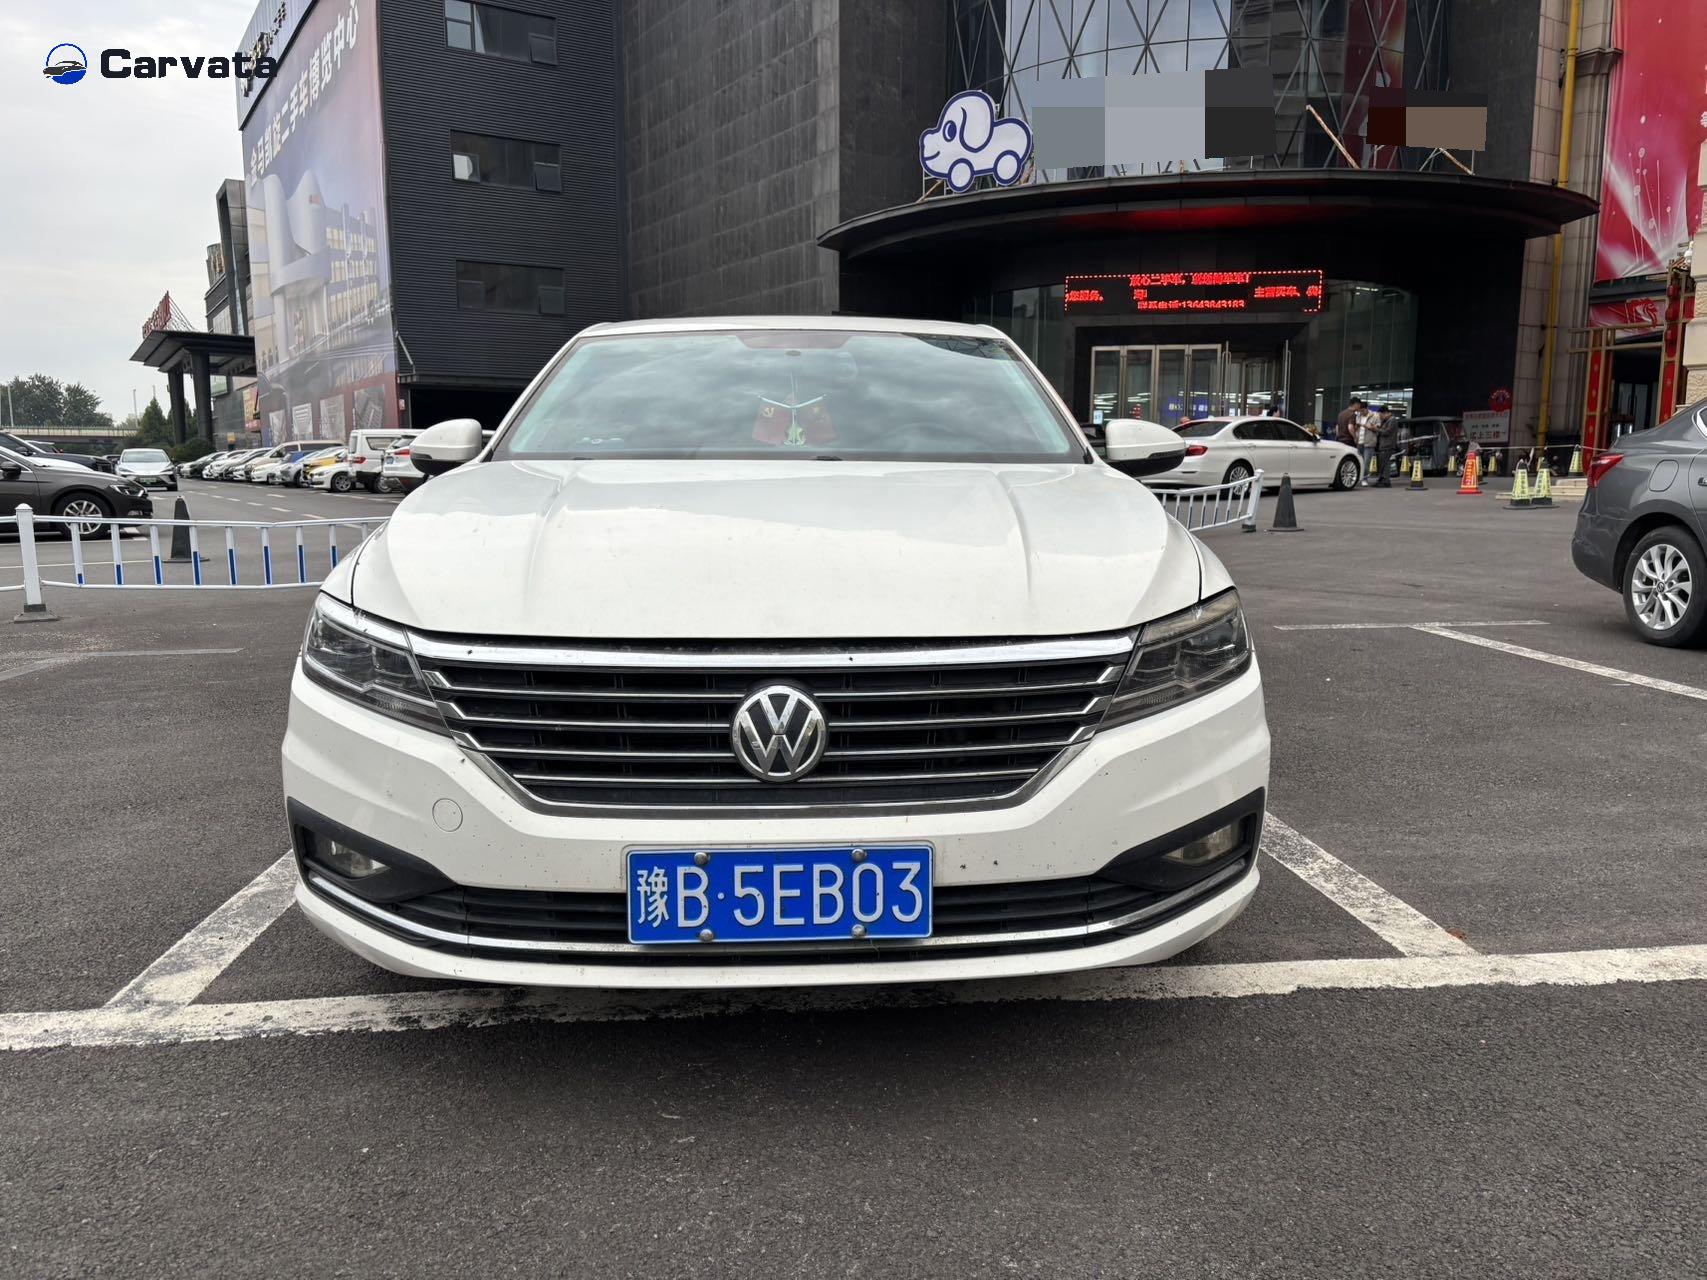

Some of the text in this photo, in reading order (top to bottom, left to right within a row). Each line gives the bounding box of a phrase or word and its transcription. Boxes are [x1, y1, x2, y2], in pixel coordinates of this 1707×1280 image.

[250, 0, 359, 187] 金马凯旋二手车博览中心
